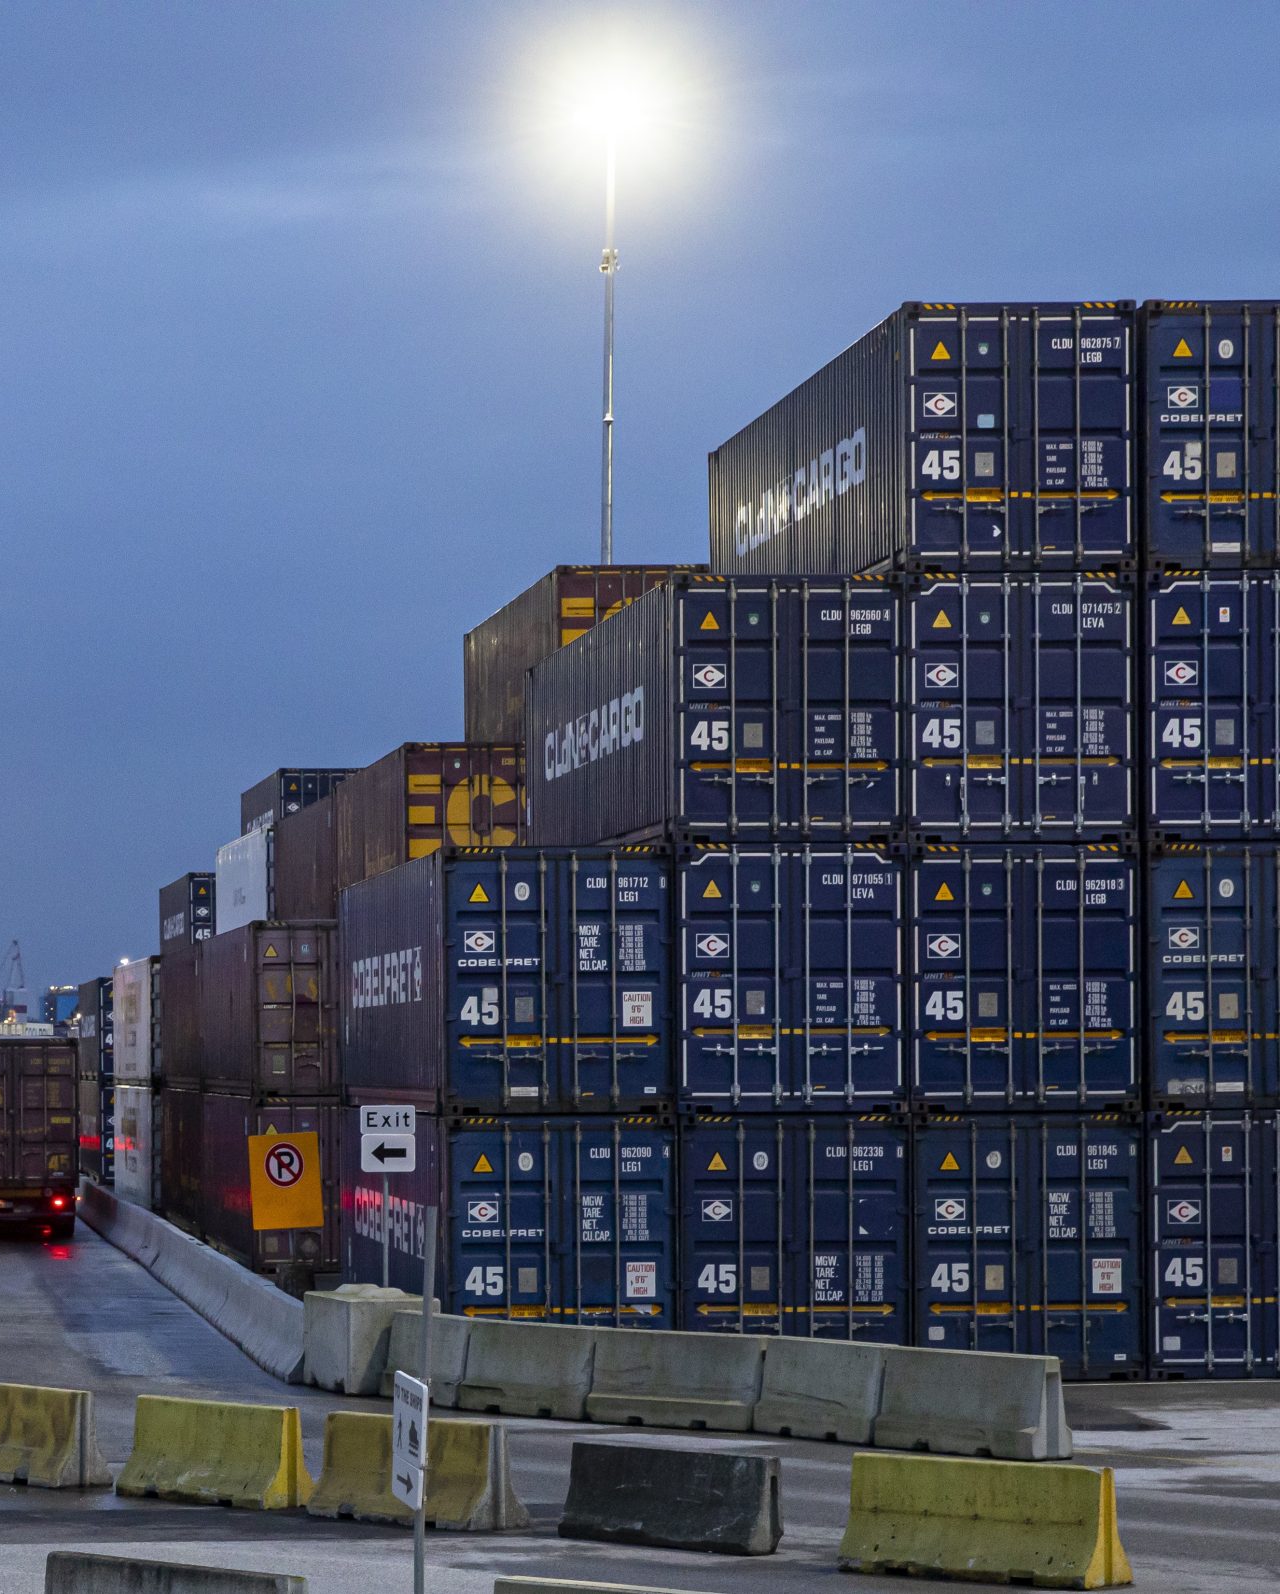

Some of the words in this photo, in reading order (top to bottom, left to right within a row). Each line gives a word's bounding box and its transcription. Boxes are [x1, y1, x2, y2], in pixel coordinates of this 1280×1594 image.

[1052, 338, 1073, 349] CLDU
[1081, 337, 1112, 348] 962875
[1114, 337, 1120, 348] 7
[1081, 352, 1102, 363] LEGB
[1160, 414, 1243, 423] COBELFRET
[922, 450, 960, 480] 45
[1163, 451, 1202, 480] 45
[793, 426, 866, 522] CARGO
[1052, 603, 1073, 615] CLDU
[1082, 602, 1113, 614] 971475
[1115, 602, 1121, 614] 2
[821, 610, 842, 621] CLDU
[850, 609, 881, 621] 962660
[883, 609, 890, 621] 4
[1082, 617, 1104, 629] LEVA
[851, 624, 872, 635] LEGB
[588, 685, 644, 762] CARGO
[690, 721, 730, 750] 45
[922, 718, 961, 748] 45
[1162, 718, 1201, 748] 45
[408, 774, 526, 857] EC
[586, 877, 607, 889] CLDU
[618, 877, 649, 888] 961712
[822, 874, 844, 885] CLDU
[852, 873, 883, 884] 971055
[1056, 879, 1077, 891] CLDU
[1085, 879, 1116, 890] 962918
[1117, 879, 1124, 890] 3
[619, 891, 639, 902] LEG1
[852, 888, 874, 899] LEVA
[1085, 893, 1107, 904] LEGB
[579, 925, 601, 936] MGW.
[579, 936, 600, 947] TARE.
[579, 948, 596, 959] NET.
[1163, 954, 1245, 963] COBELFRET
[458, 958, 540, 967] COBELFRET
[352, 948, 413, 1009] COBELFRET
[623, 993, 651, 1002] CAUTION
[693, 989, 732, 1018] 45
[925, 990, 964, 1020] 45
[1166, 991, 1204, 1021] 45
[460, 996, 499, 1025] 45
[629, 1016, 644, 1024] HIGH
[367, 1111, 411, 1128] Exit
[589, 1148, 611, 1159] CLDU
[621, 1147, 652, 1158] 962090
[663, 1146, 670, 1158] 4
[826, 1146, 847, 1158] CLDU
[852, 1146, 884, 1157] 962336
[1056, 1146, 1077, 1156] CLDU
[1087, 1145, 1118, 1156] 961845
[622, 1161, 641, 1172] LEG1
[853, 1160, 873, 1171] LEG1
[1088, 1159, 1108, 1170] LEG1
[582, 1195, 605, 1206] MGW.
[1049, 1192, 1071, 1203] MGW.
[582, 1207, 604, 1218] TARE.
[1049, 1204, 1070, 1215] TARE.
[582, 1219, 599, 1230] NET.
[1049, 1215, 1065, 1226] NET.
[462, 1229, 544, 1238] COBELFRET
[928, 1226, 1010, 1234] COBELFRET
[815, 1255, 840, 1266] MGW.
[1093, 1260, 1120, 1269] CAUTION
[627, 1264, 655, 1272] CAUTION
[815, 1267, 839, 1278] TARE.
[1165, 1257, 1204, 1287] 45
[465, 1266, 503, 1296] 45
[698, 1264, 737, 1294] 45
[930, 1263, 969, 1293] 45
[815, 1279, 834, 1290] NET.
[1098, 1283, 1114, 1291] HIGH
[633, 1287, 648, 1295] HIGH
